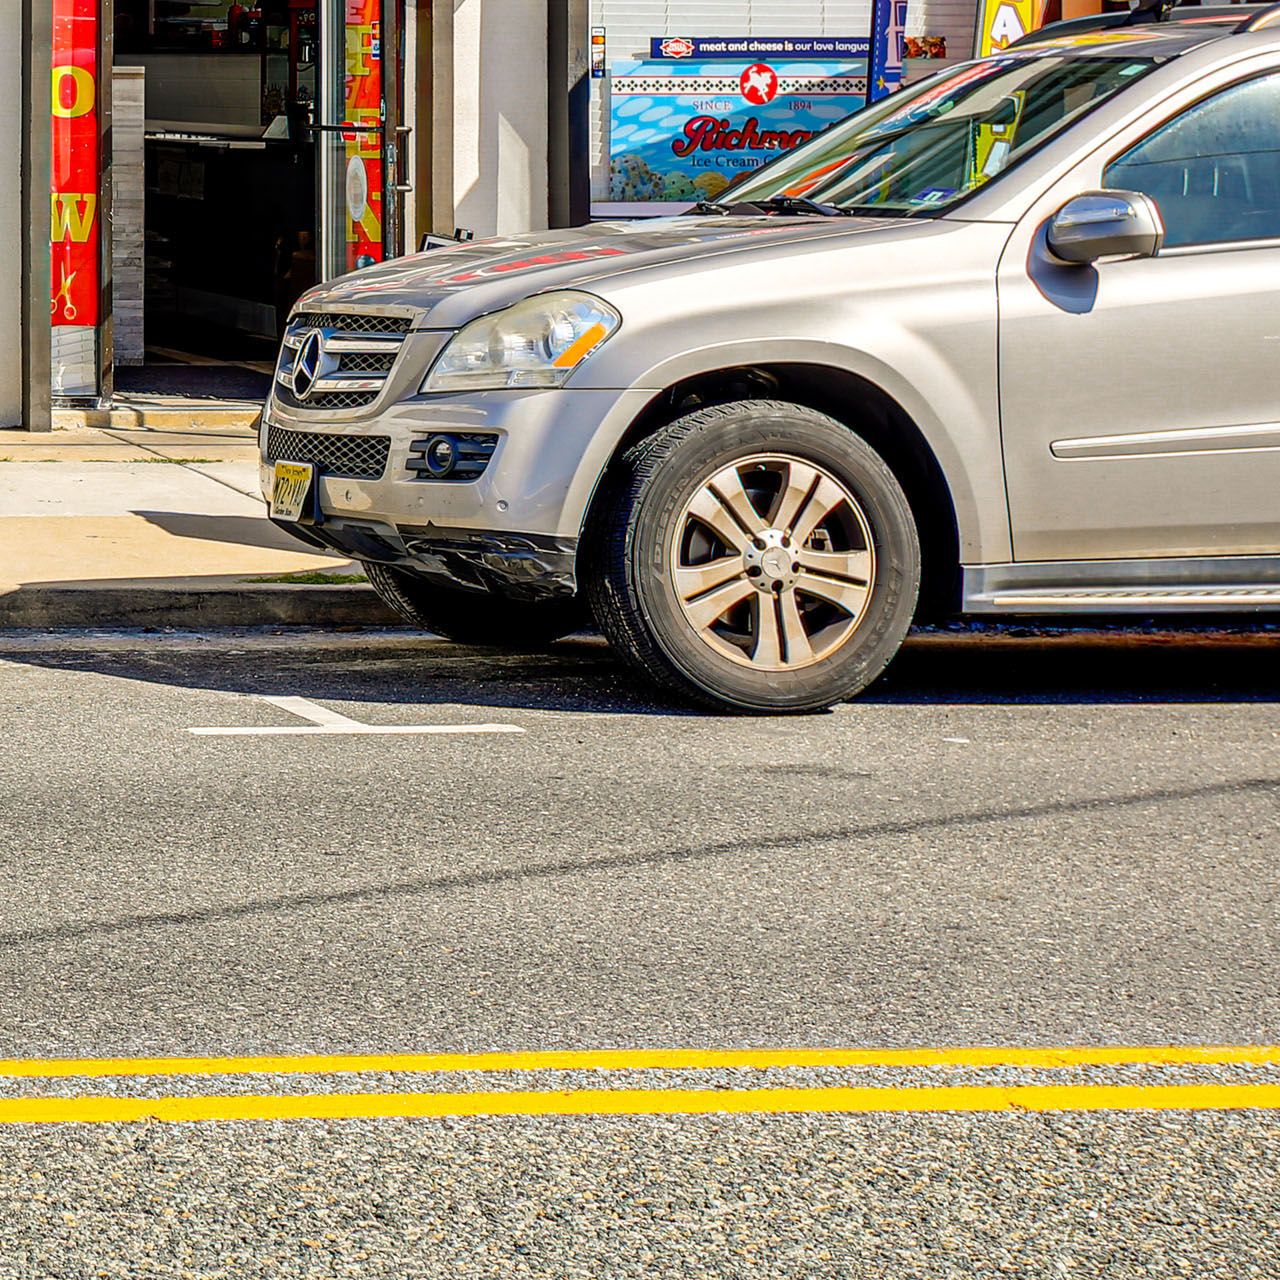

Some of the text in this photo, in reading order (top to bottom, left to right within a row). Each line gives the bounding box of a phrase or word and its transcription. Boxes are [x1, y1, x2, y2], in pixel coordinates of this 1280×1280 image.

[699, 42, 726, 51] meat
[728, 41, 747, 51] and
[749, 41, 783, 51] cheese
[784, 41, 793, 51] is
[795, 43, 810, 51] our
[813, 41, 834, 51] love
[835, 41, 870, 53] langua
[692, 100, 812, 111] SINCE 1894
[691, 155, 711, 167] Ice
[715, 156, 758, 167] Cream
